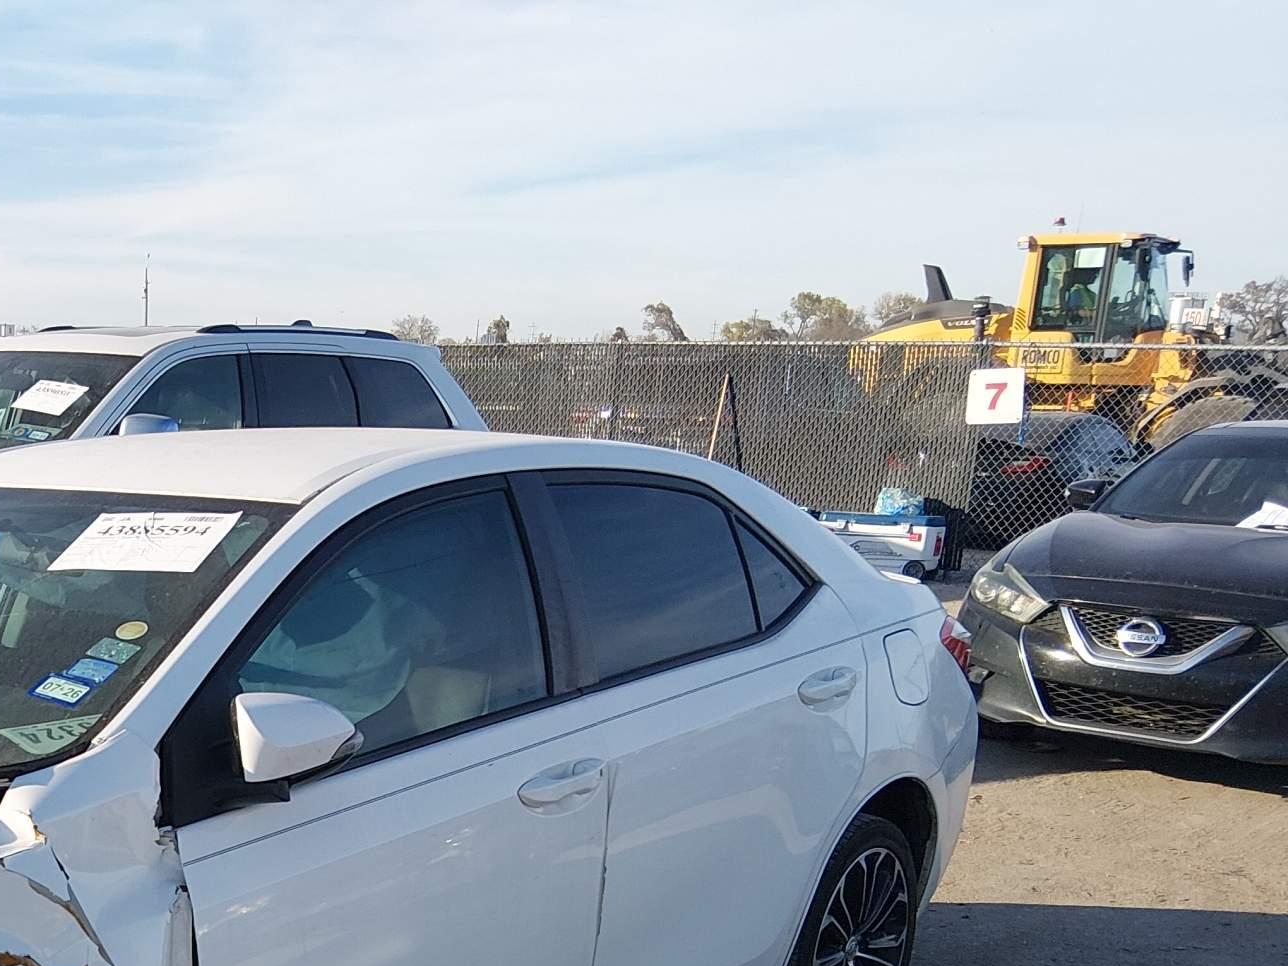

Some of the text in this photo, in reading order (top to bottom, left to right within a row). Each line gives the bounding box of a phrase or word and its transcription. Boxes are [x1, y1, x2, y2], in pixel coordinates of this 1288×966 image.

[1021, 348, 1061, 365] ROMCO
[985, 383, 1008, 410] 7
[96, 524, 213, 537] 43885594
